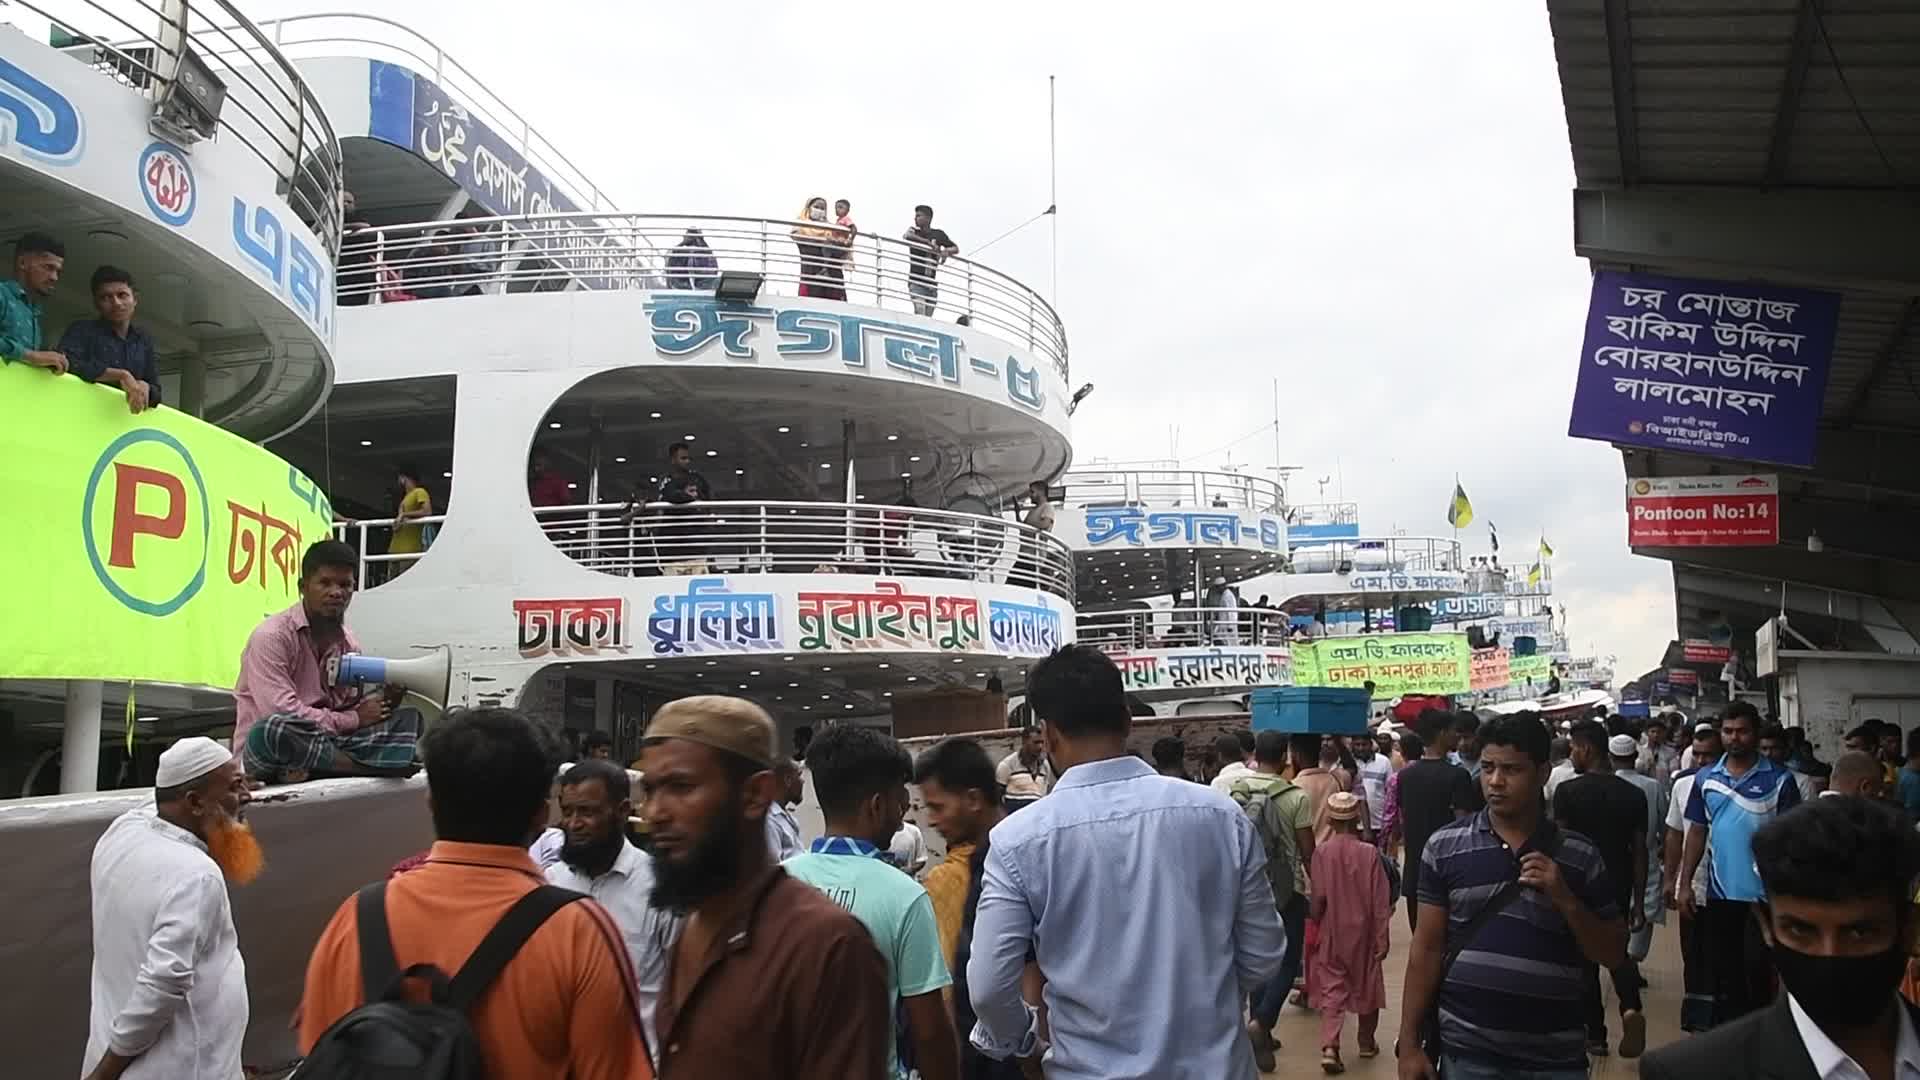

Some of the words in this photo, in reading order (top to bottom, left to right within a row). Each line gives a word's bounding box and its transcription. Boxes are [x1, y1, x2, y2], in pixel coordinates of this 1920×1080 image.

[1620, 286, 1667, 310] চর
[1677, 292, 1800, 324] মোন্তাজ
[1605, 312, 1704, 345] হাকিম
[1711, 318, 1806, 356] উদ্দিন
[1594, 345, 1809, 388] বোরহানউদ্দিন
[1612, 376, 1777, 416] লালমোহন
[108, 462, 187, 569] P
[1633, 505, 1707, 521] Pontoon
[227, 500, 303, 597] ঢাকা
[513, 597, 628, 657] ঢাকা
[648, 578, 782, 655] ধুলিয়া
